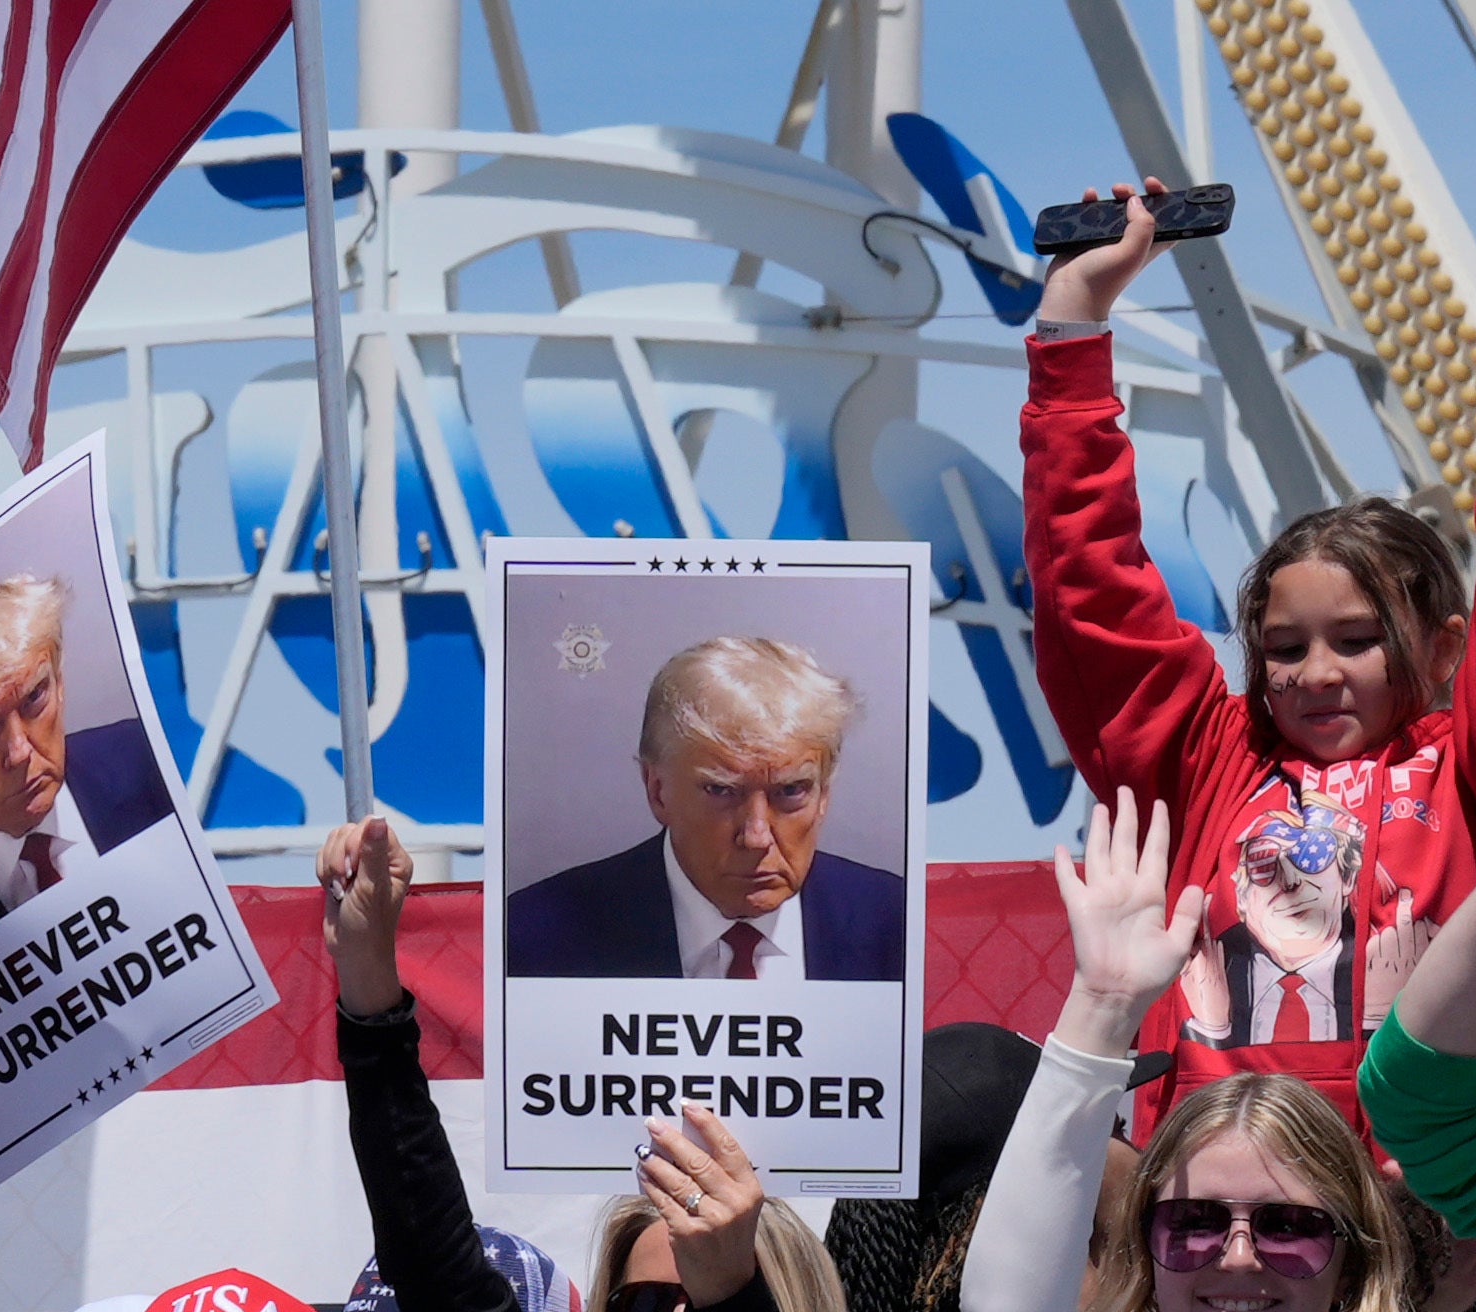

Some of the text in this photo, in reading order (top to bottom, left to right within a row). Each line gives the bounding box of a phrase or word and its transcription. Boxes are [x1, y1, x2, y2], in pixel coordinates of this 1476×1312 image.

[1380, 797, 1440, 832] 2024
[602, 1014, 804, 1057] NEVER
[522, 1074, 885, 1120] SURRENDER
